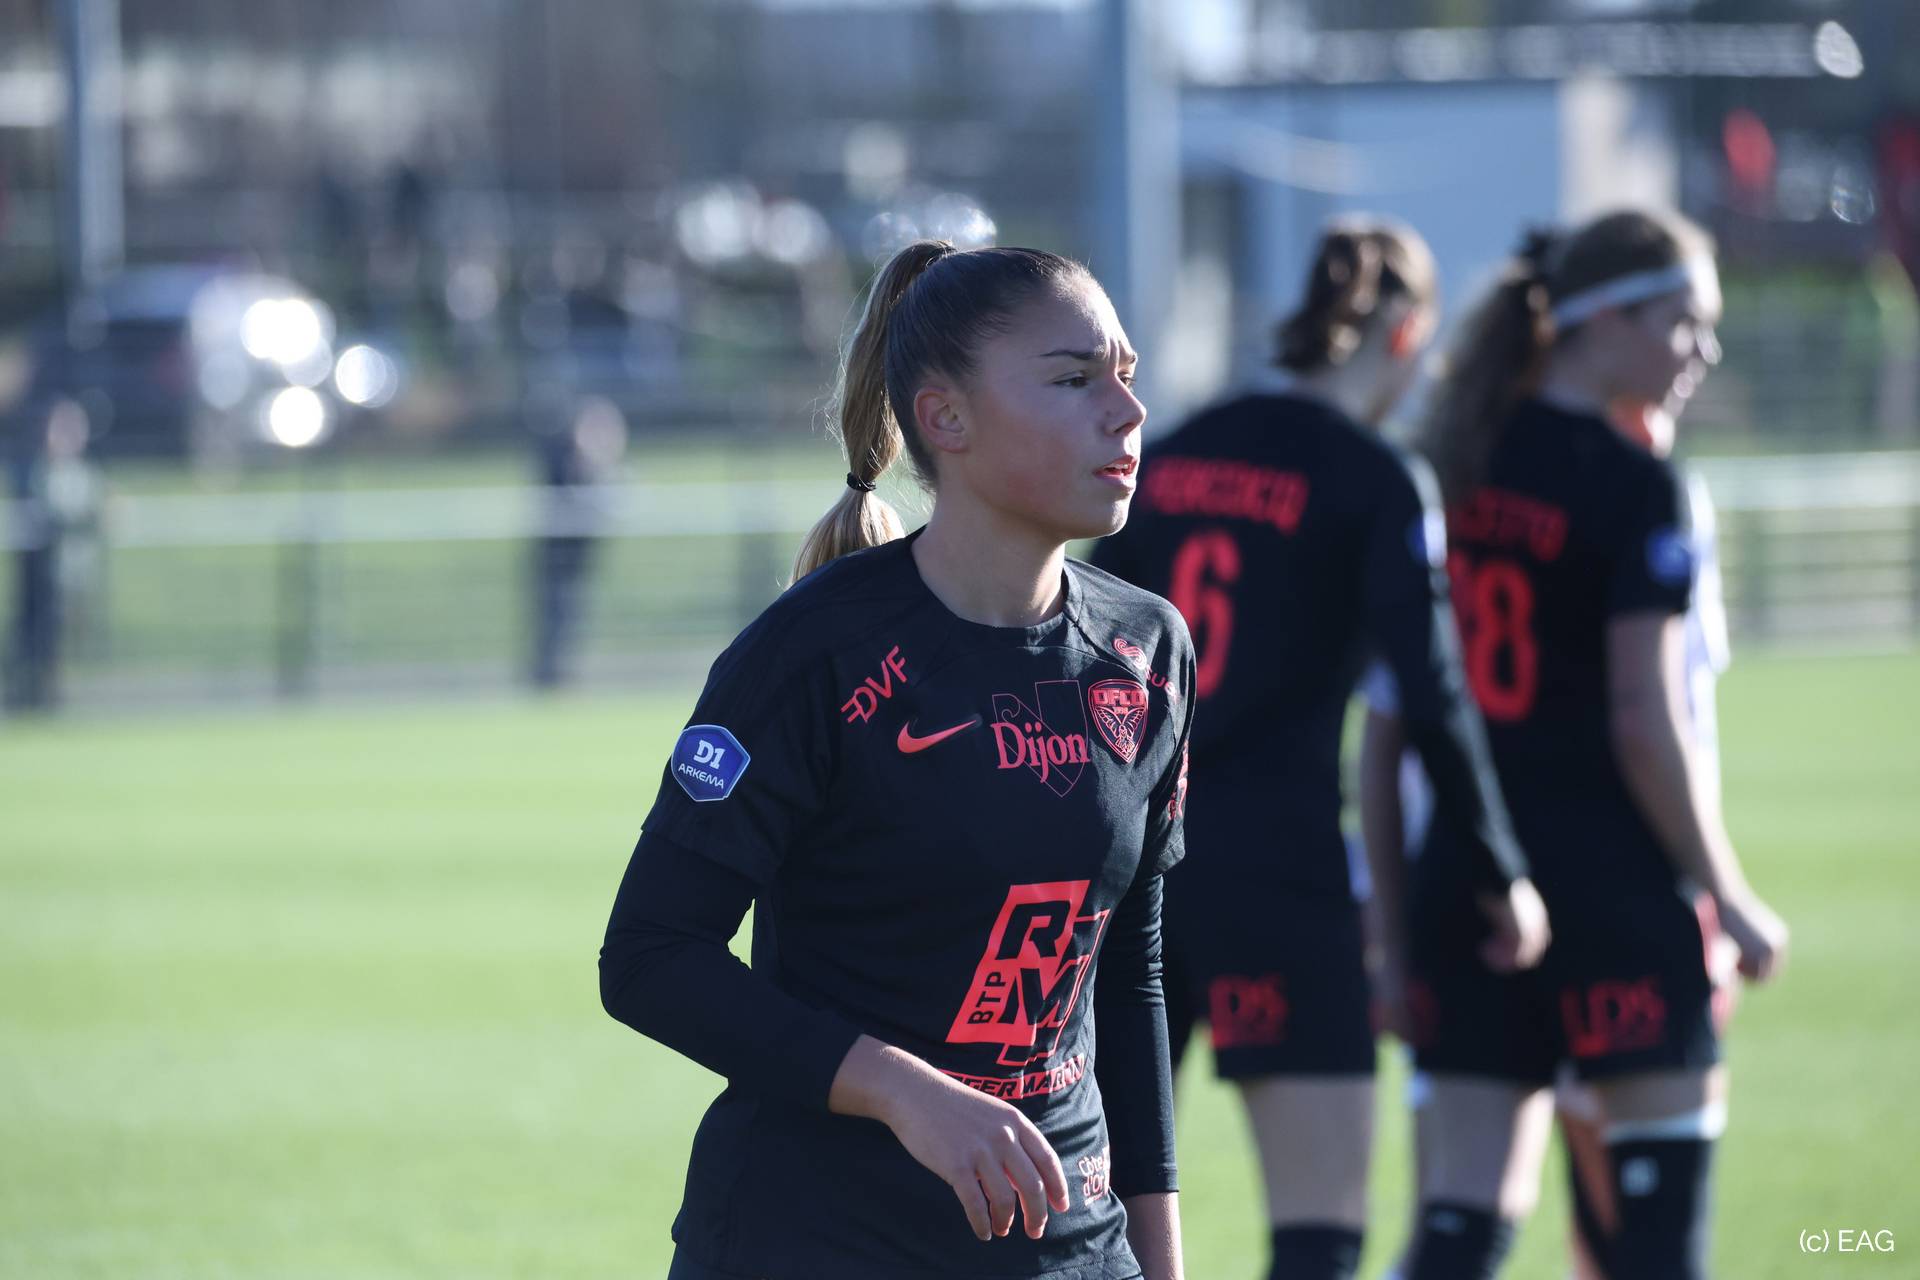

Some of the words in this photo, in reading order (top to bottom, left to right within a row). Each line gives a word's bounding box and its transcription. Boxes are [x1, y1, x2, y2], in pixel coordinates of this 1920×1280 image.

[1168, 530, 1241, 698] 6
[1092, 688, 1145, 706] DFCO
[693, 739, 726, 770] D1
[990, 721, 1091, 783] Dijon
[678, 763, 725, 789] ARKEMA
[967, 971, 1006, 1025] BTP
